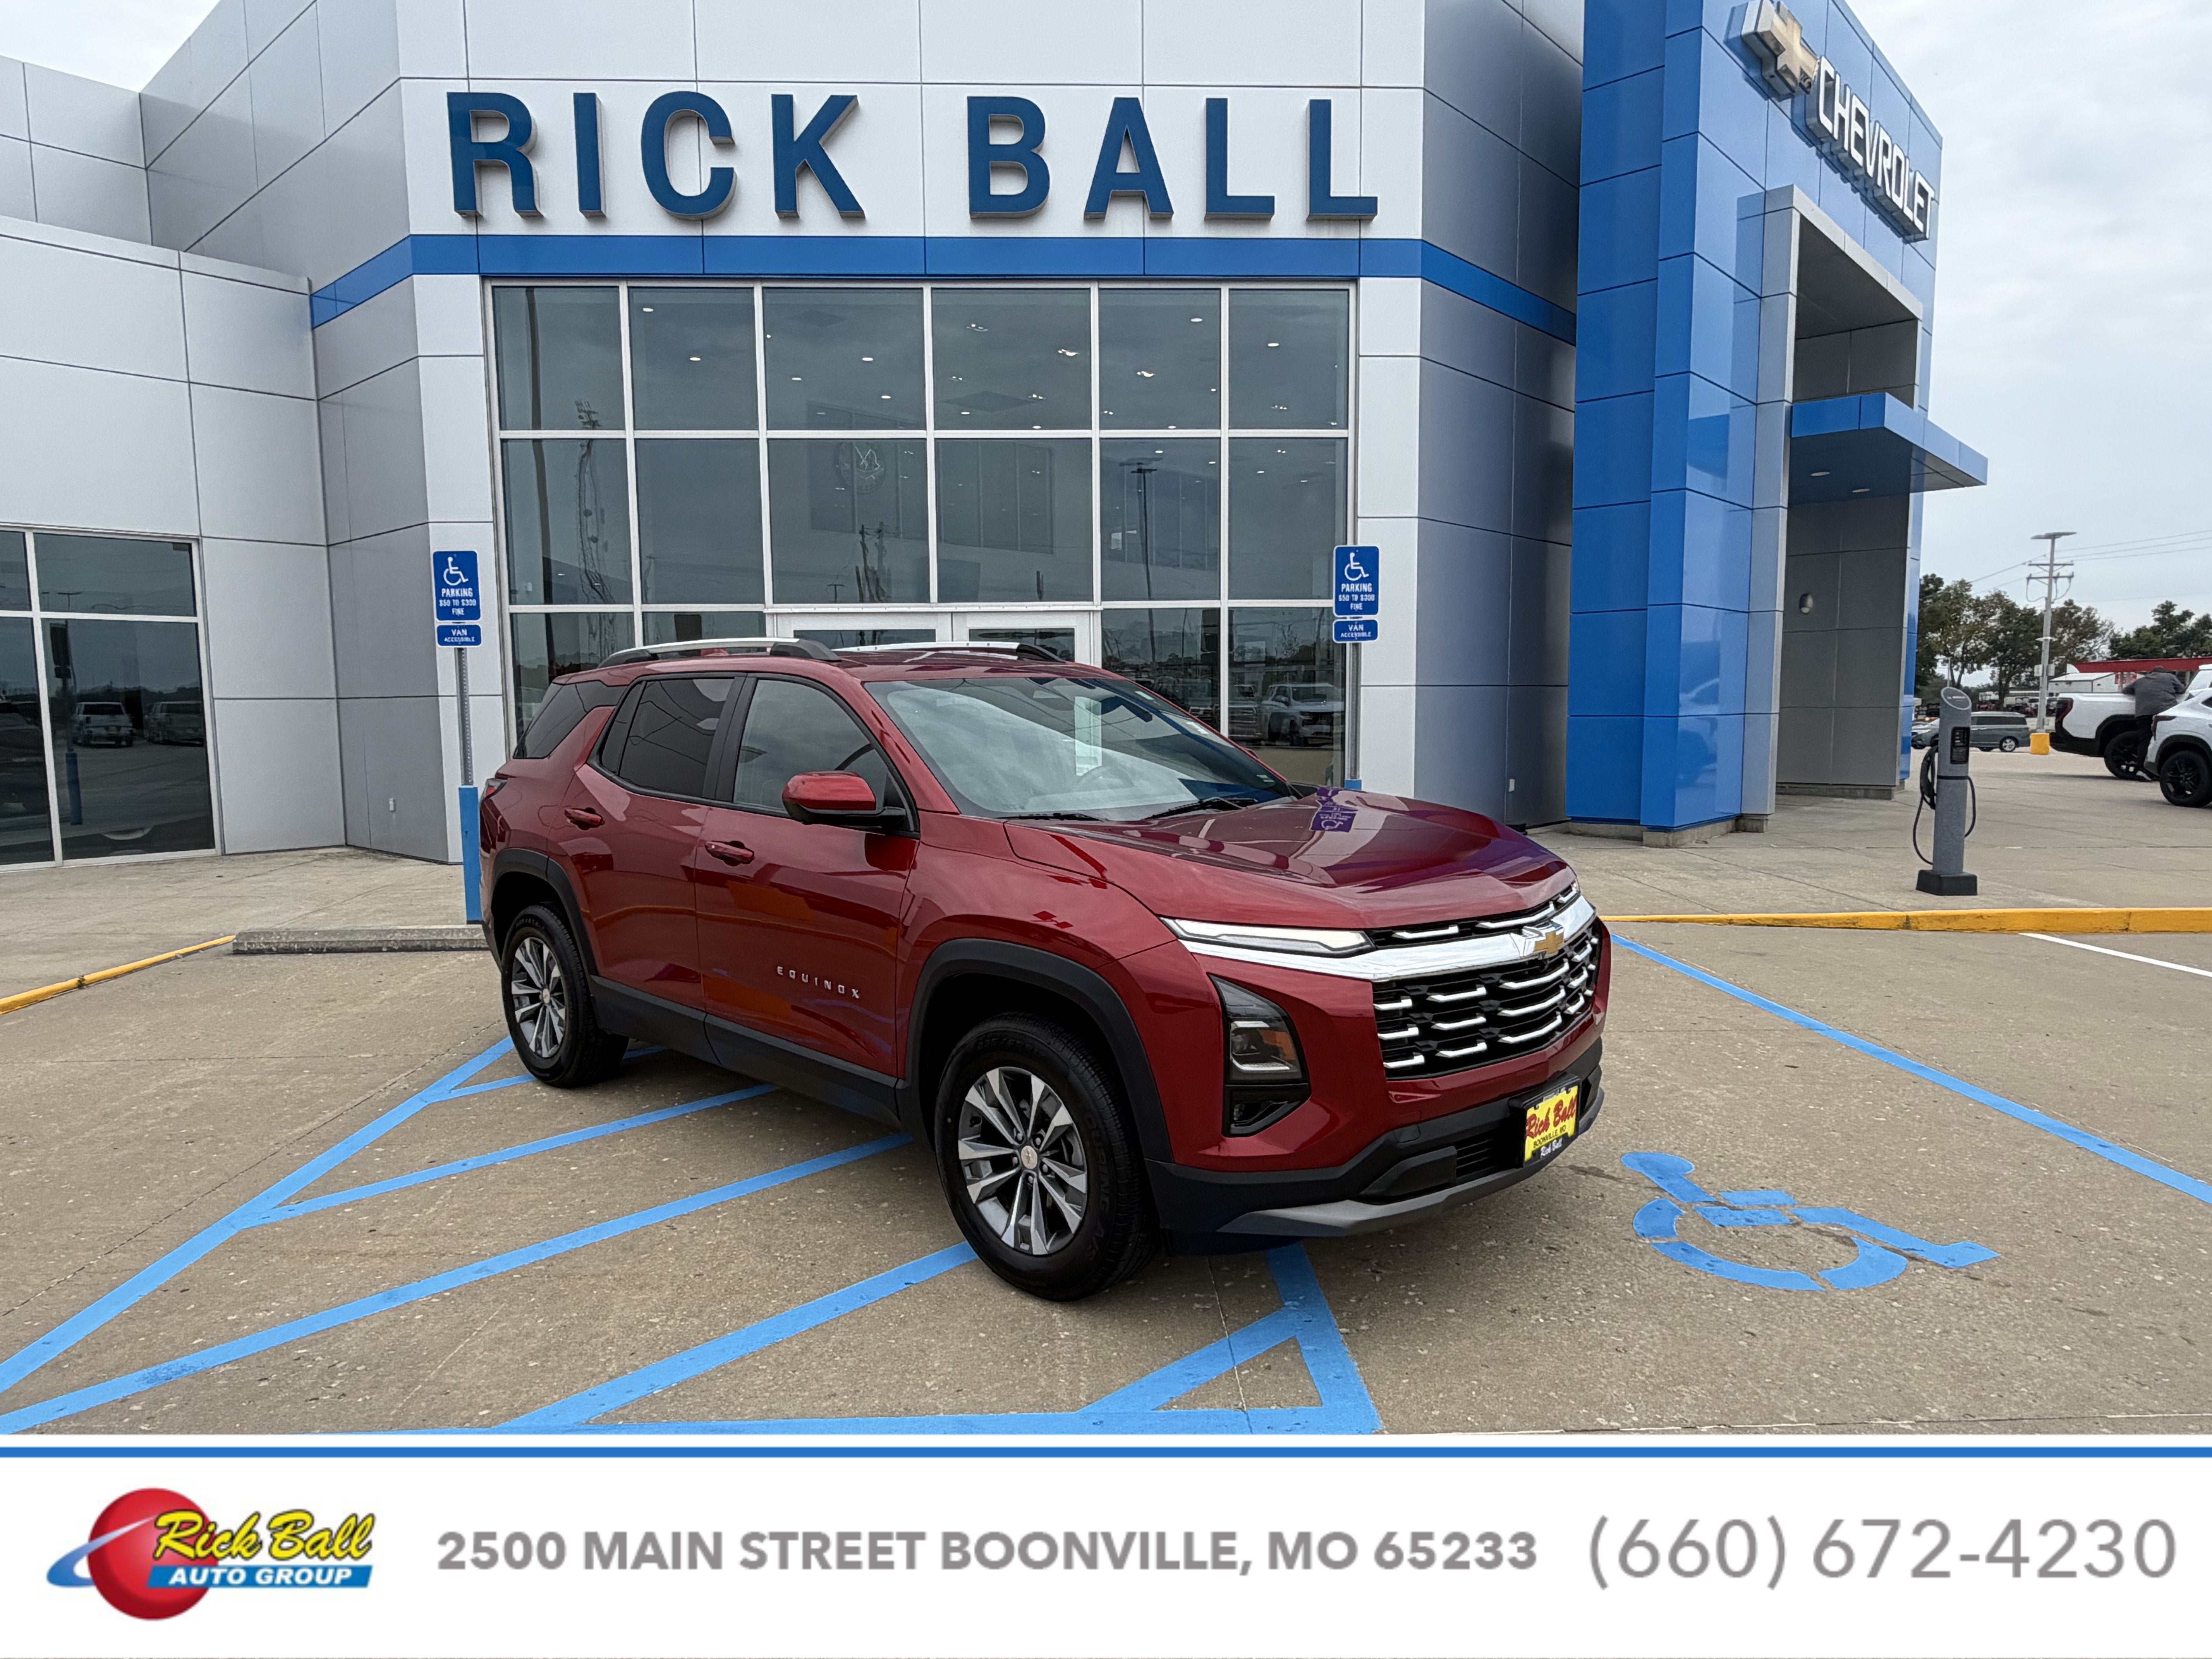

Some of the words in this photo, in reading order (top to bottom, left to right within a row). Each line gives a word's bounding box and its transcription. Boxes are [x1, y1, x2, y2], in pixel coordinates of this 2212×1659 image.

[447, 92, 866, 219] RICK
[967, 96, 1378, 220] BALL
[1819, 55, 1935, 240] CHEVROLET
[441, 588, 473, 597] PARKING
[1341, 583, 1372, 592] PARKING
[777, 966, 859, 999] EQUINOX
[1526, 1107, 1551, 1139] Rick
[1553, 1095, 1577, 1128] Ball
